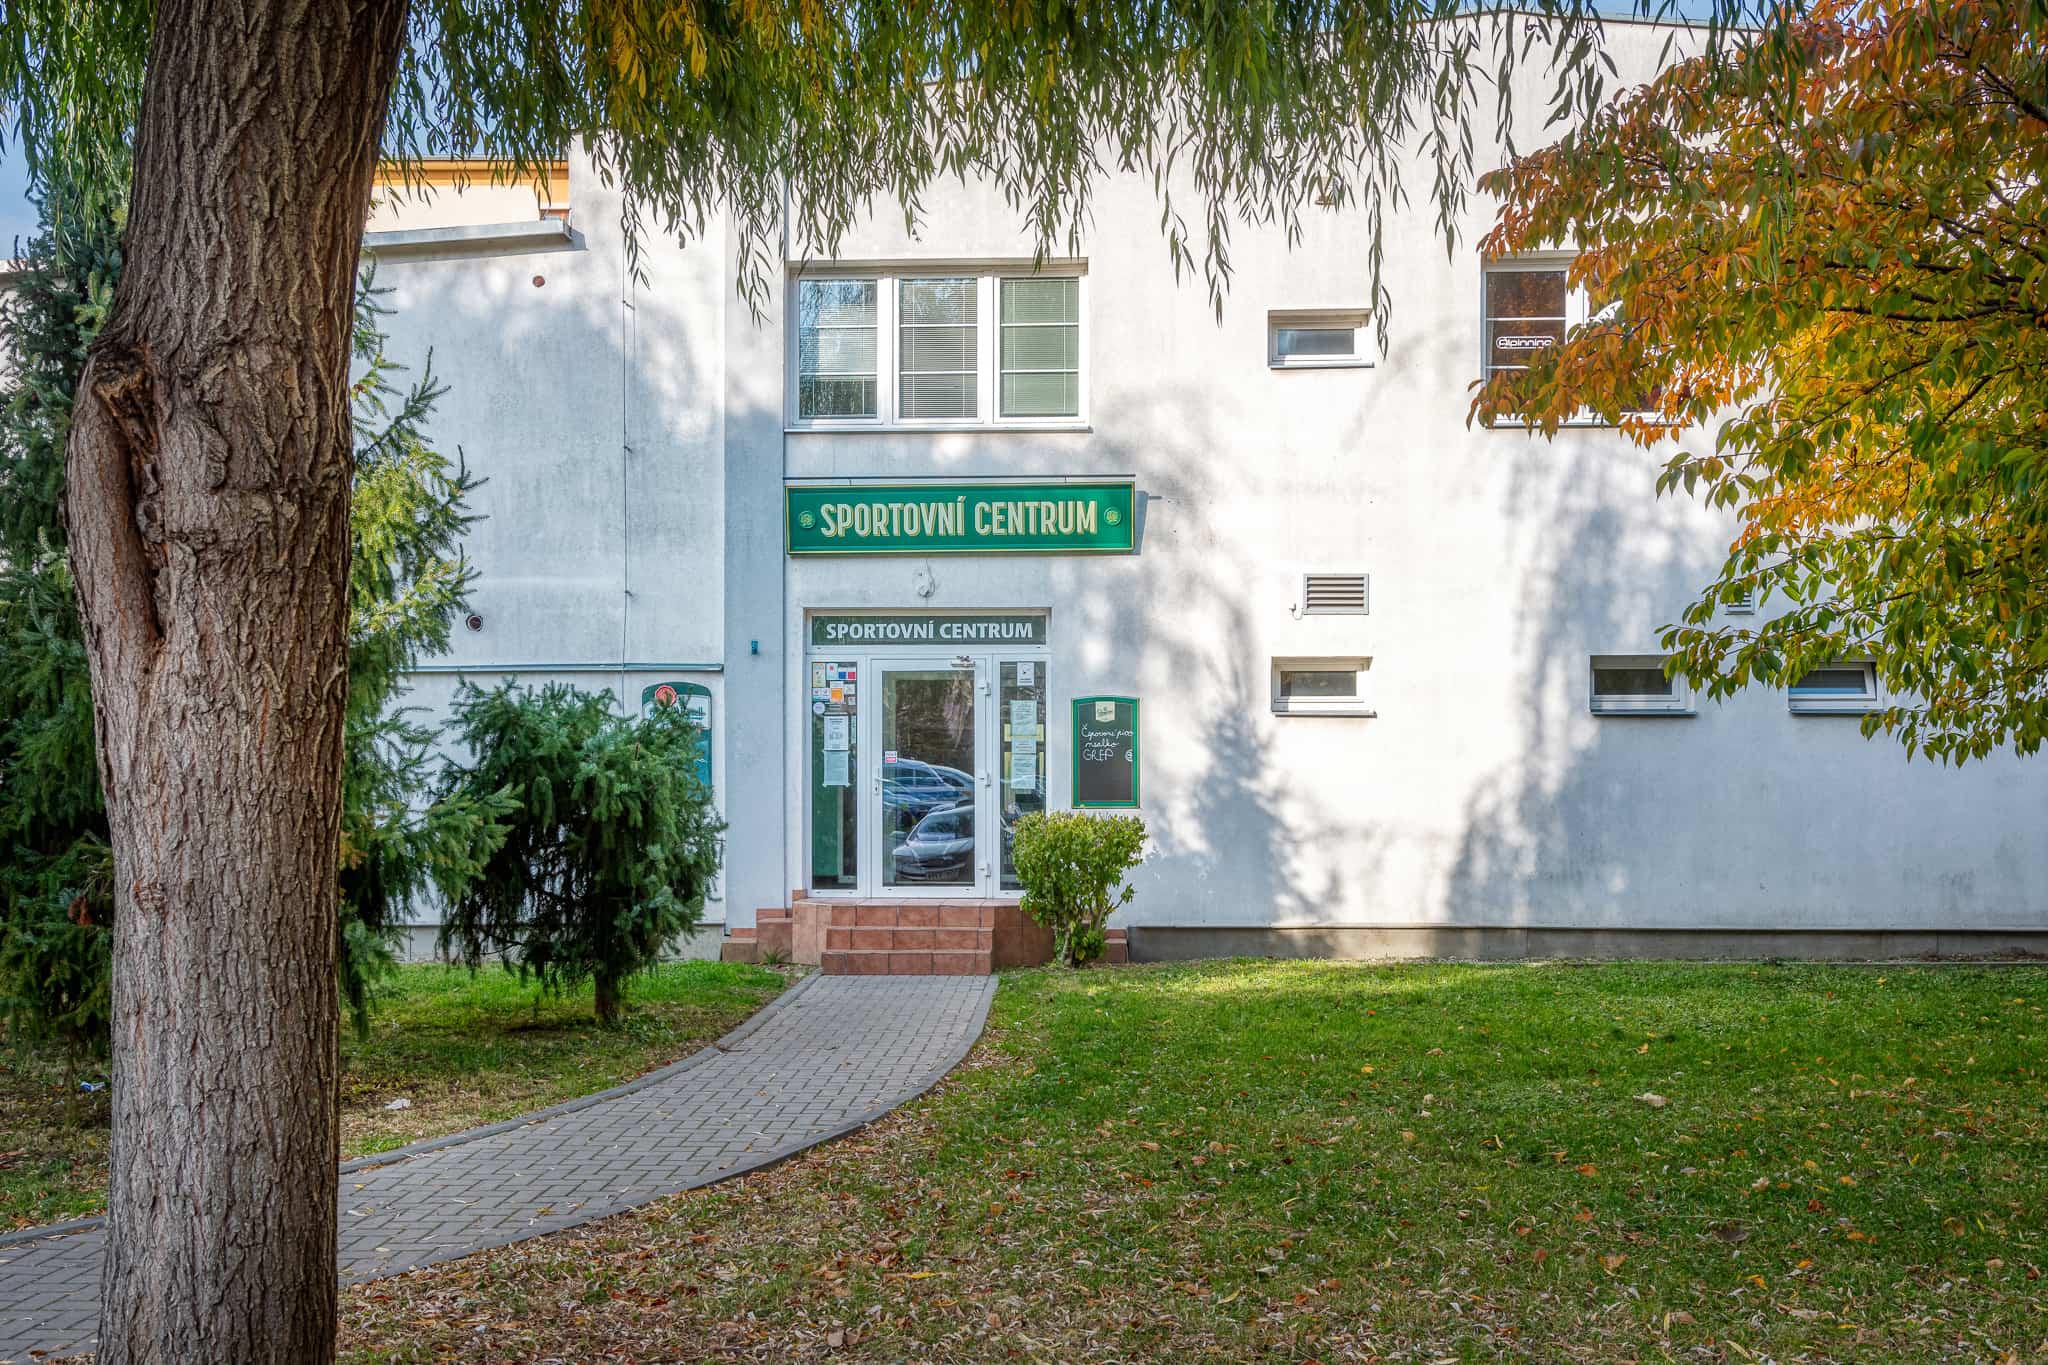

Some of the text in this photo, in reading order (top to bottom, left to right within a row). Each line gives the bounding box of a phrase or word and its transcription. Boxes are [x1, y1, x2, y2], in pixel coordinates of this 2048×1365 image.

[820, 496, 1098, 538] SPORTOVNÍ CENTRUM
[826, 620, 1033, 639] SPORTOVNÍ CENTRUM
